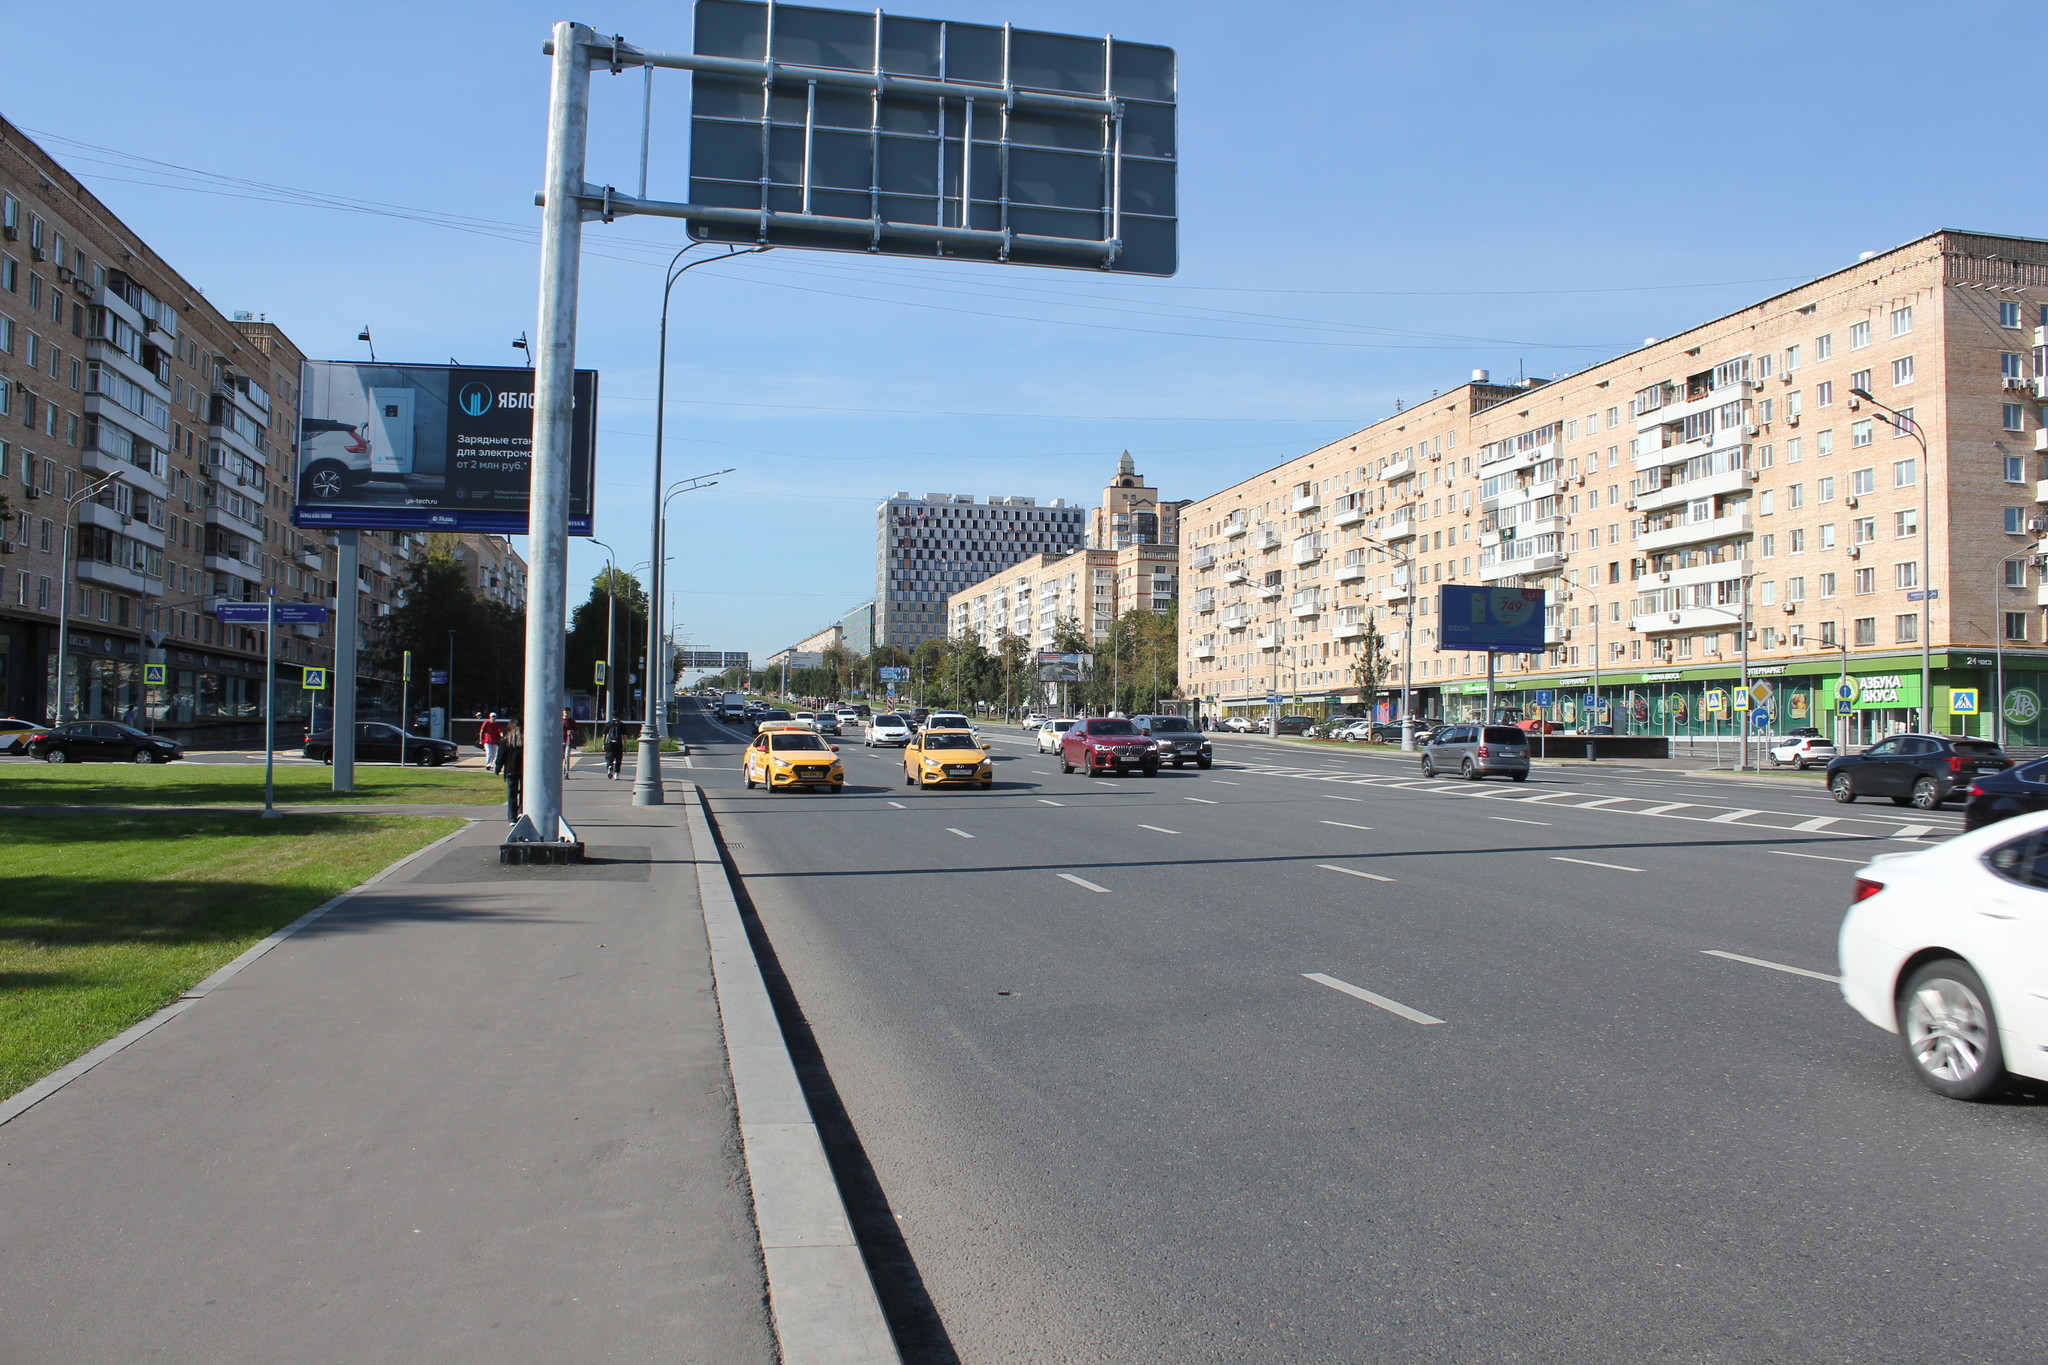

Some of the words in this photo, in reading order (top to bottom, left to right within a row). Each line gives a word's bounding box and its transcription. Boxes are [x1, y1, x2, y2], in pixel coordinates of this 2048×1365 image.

[457, 434, 509, 446] Зарядные
[456, 449, 476, 457] для
[470, 461, 477, 469] 2
[479, 462, 500, 470] млн
[1500, 601, 1523, 612] 749
[1966, 657, 1977, 665] 24
[1746, 665, 1786, 676] УПЕРМАРКЕТ
[1859, 675, 1902, 690] АЗБУКА
[1862, 689, 1900, 703] ВКУСА
